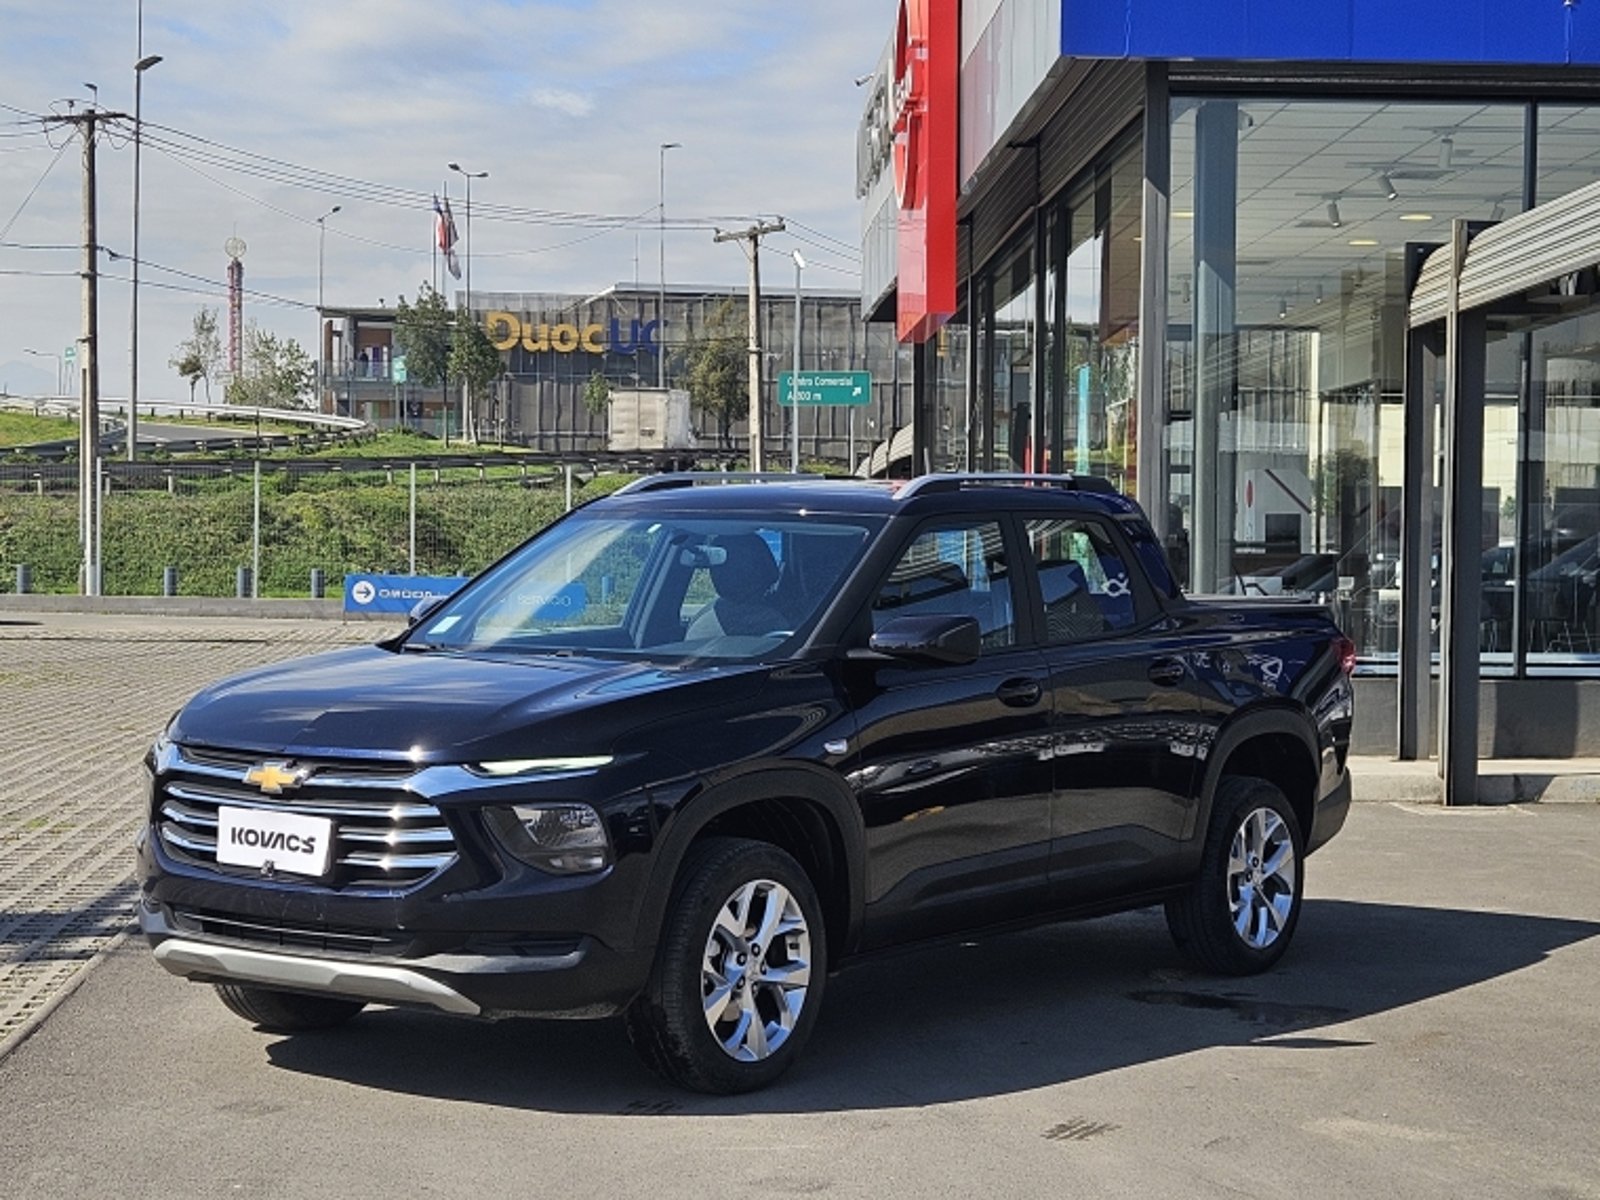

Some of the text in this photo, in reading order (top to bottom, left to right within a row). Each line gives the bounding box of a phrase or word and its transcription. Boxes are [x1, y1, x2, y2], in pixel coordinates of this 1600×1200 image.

[787, 376, 853, 386] Cntro Comercial
[812, 393, 822, 401] m
[231, 827, 316, 854] KOVACS
